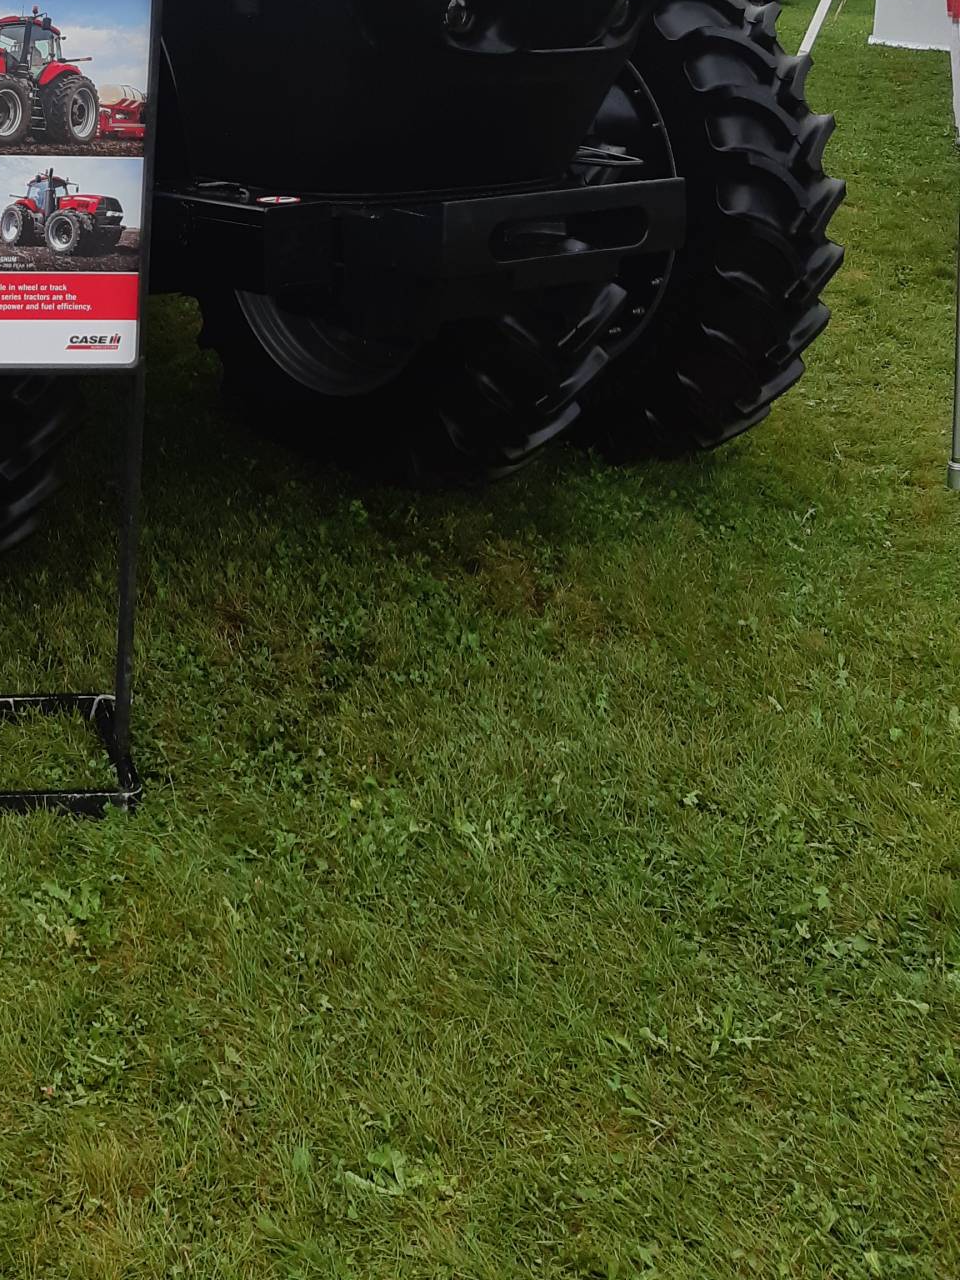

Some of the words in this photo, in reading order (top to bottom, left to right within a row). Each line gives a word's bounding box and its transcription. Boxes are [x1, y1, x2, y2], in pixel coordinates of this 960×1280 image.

[8, 283, 16, 291] in
[18, 283, 38, 291] wheel
[40, 283, 47, 291] or
[49, 283, 67, 291] track
[1, 293, 21, 301] series
[23, 293, 50, 301] tractors
[52, 293, 63, 301] are
[65, 293, 77, 301] the
[25, 302, 39, 310] and
[41, 302, 55, 310] fuel
[56, 302, 92, 311] efficiency.
[69, 336, 108, 344] CASE
